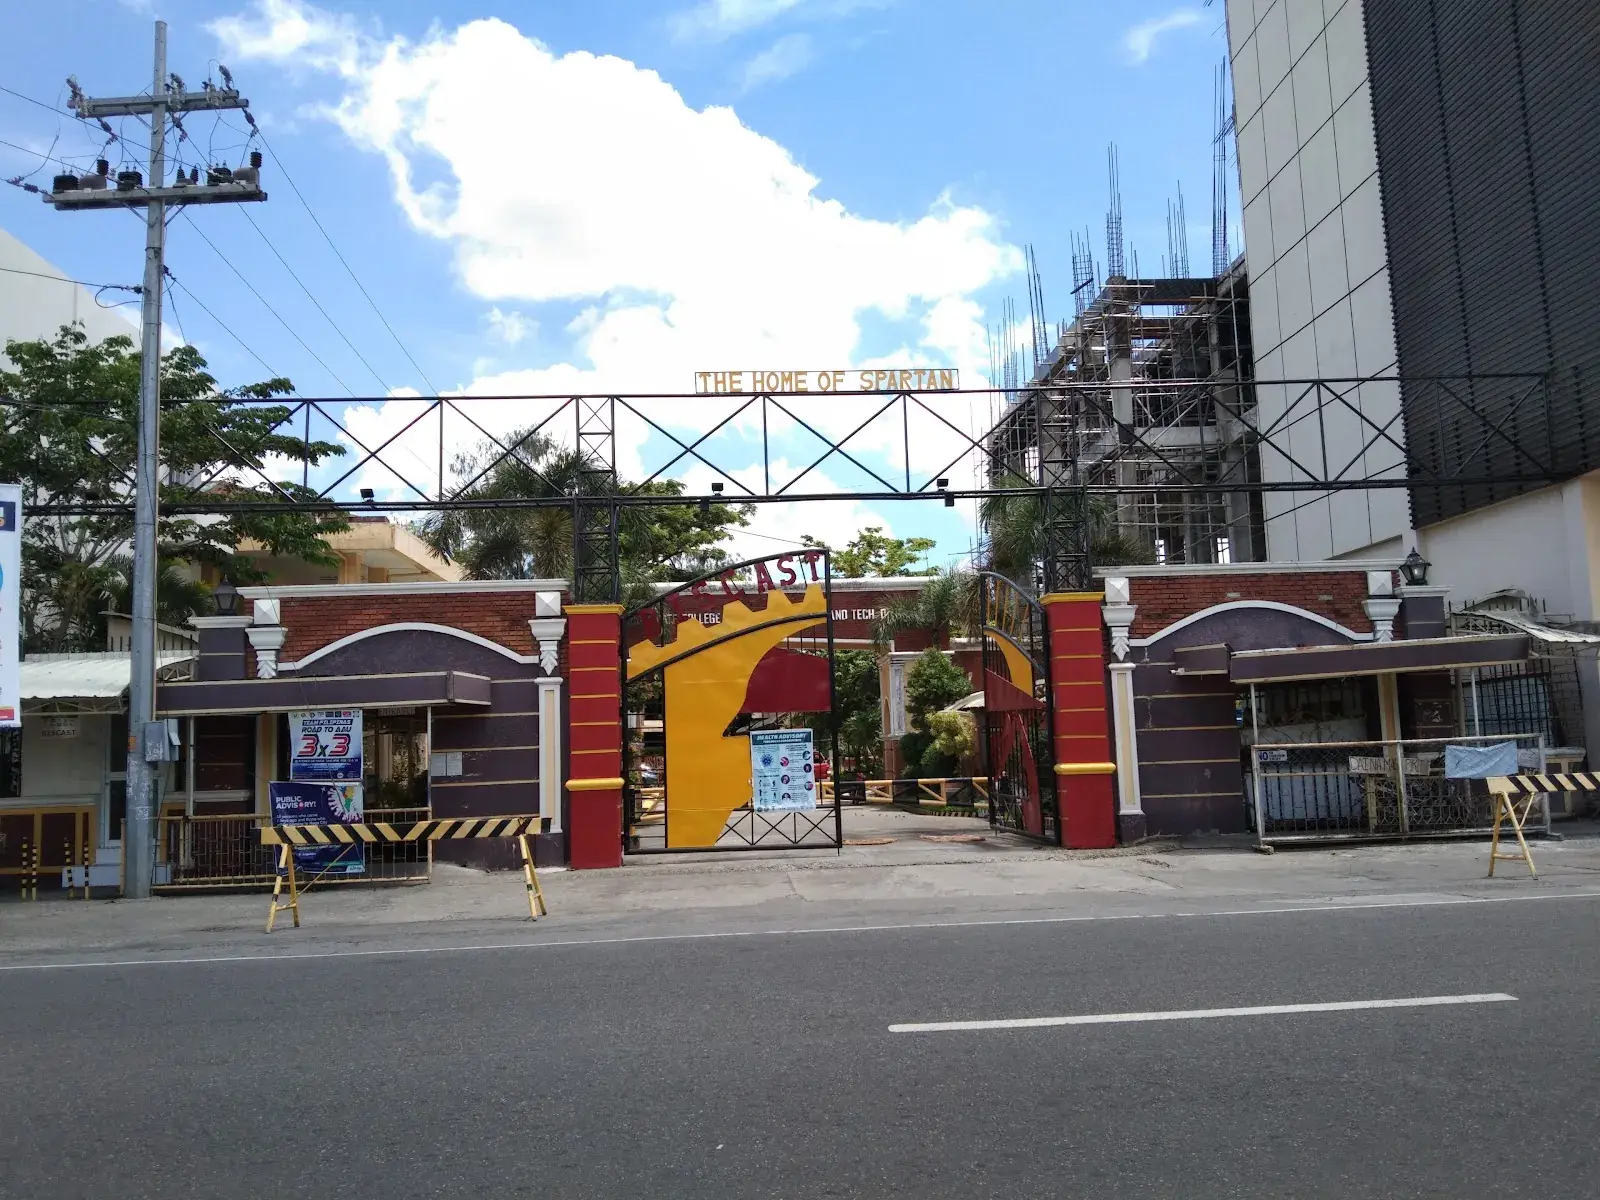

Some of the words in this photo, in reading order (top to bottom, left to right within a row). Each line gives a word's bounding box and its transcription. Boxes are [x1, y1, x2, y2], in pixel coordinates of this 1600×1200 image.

[698, 371, 743, 393] THE
[752, 371, 808, 393] HOME
[817, 370, 846, 392] OF
[859, 369, 954, 392] SPARTAN
